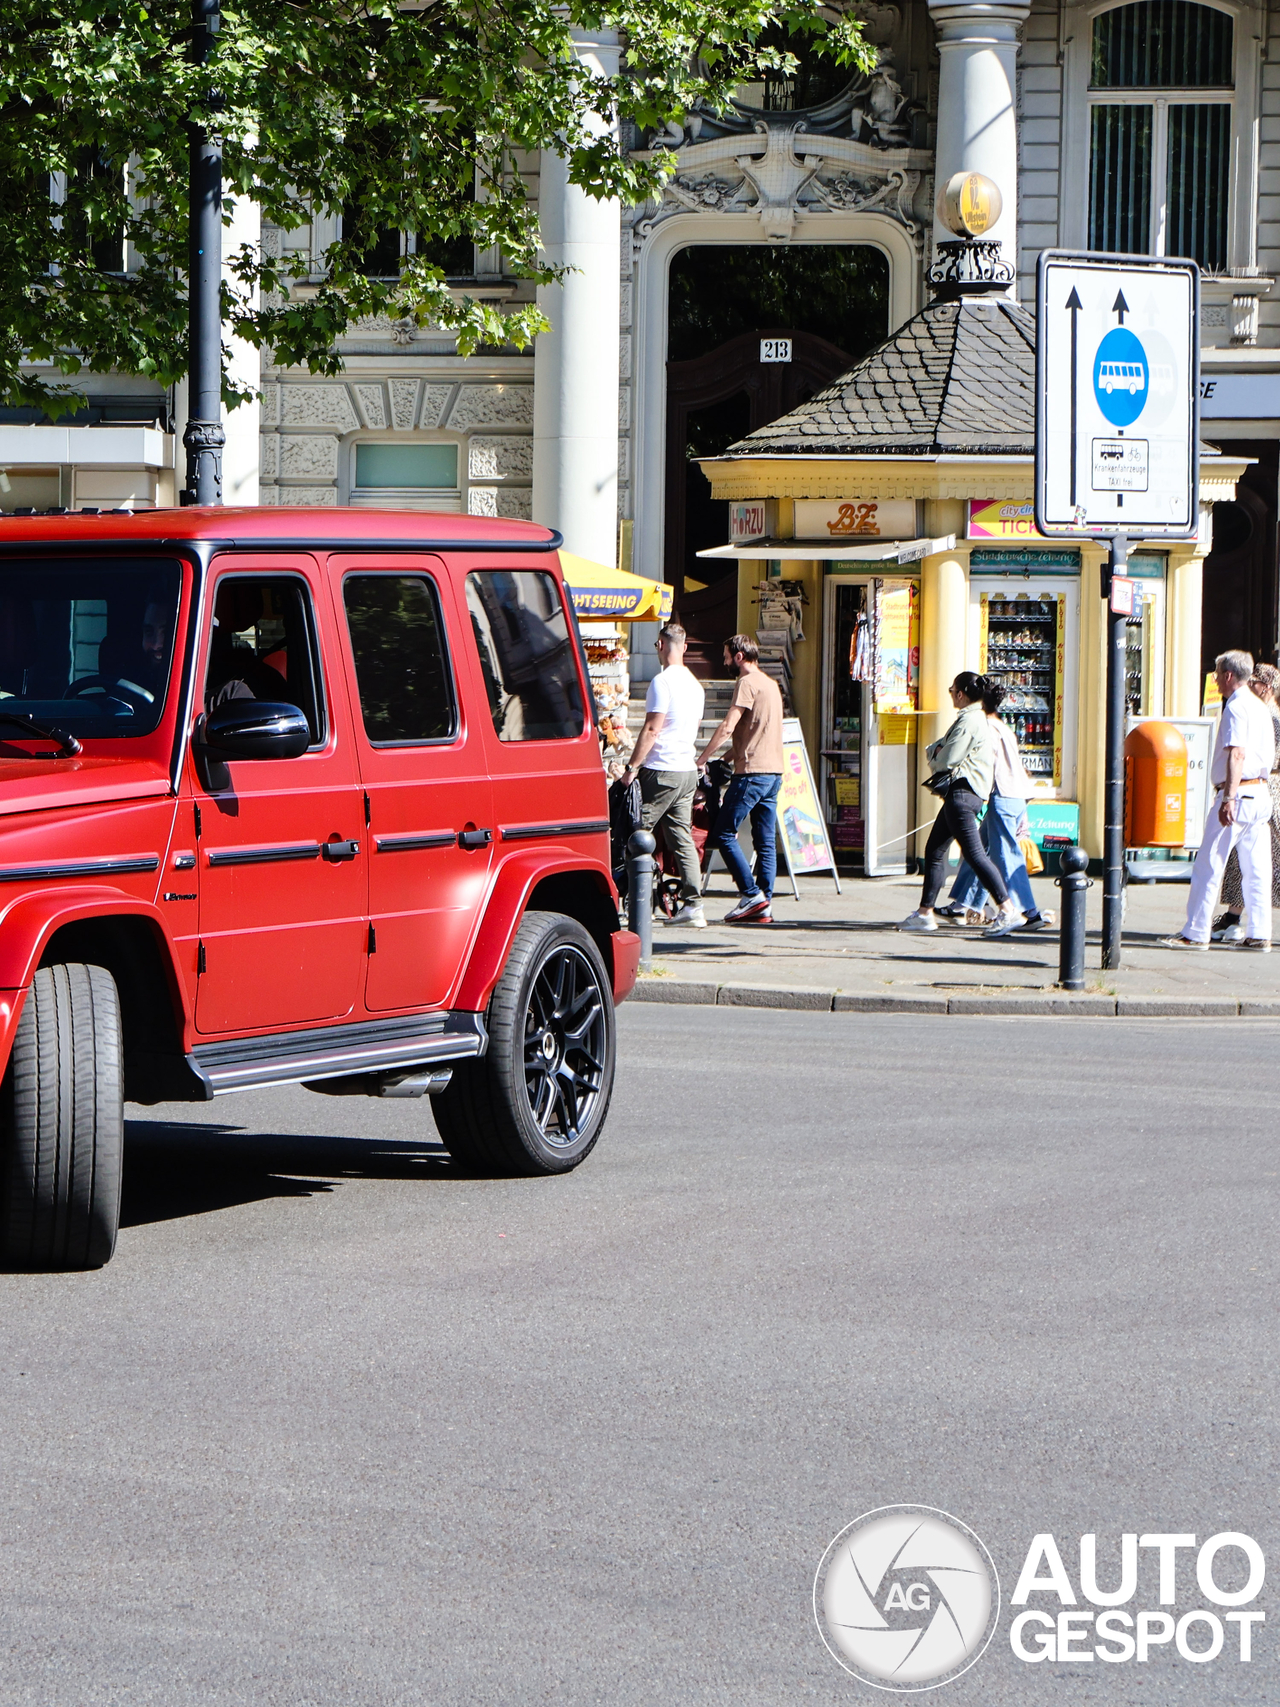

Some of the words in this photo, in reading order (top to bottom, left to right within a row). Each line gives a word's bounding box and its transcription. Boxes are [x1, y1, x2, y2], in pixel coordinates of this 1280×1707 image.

[764, 341, 788, 359] 213
[1094, 463, 1147, 476] Krankenfahrzeuge
[1108, 477, 1121, 487] TAXI
[1123, 478, 1133, 487] frei
[1000, 504, 1019, 518] city
[1020, 503, 1035, 515] cir
